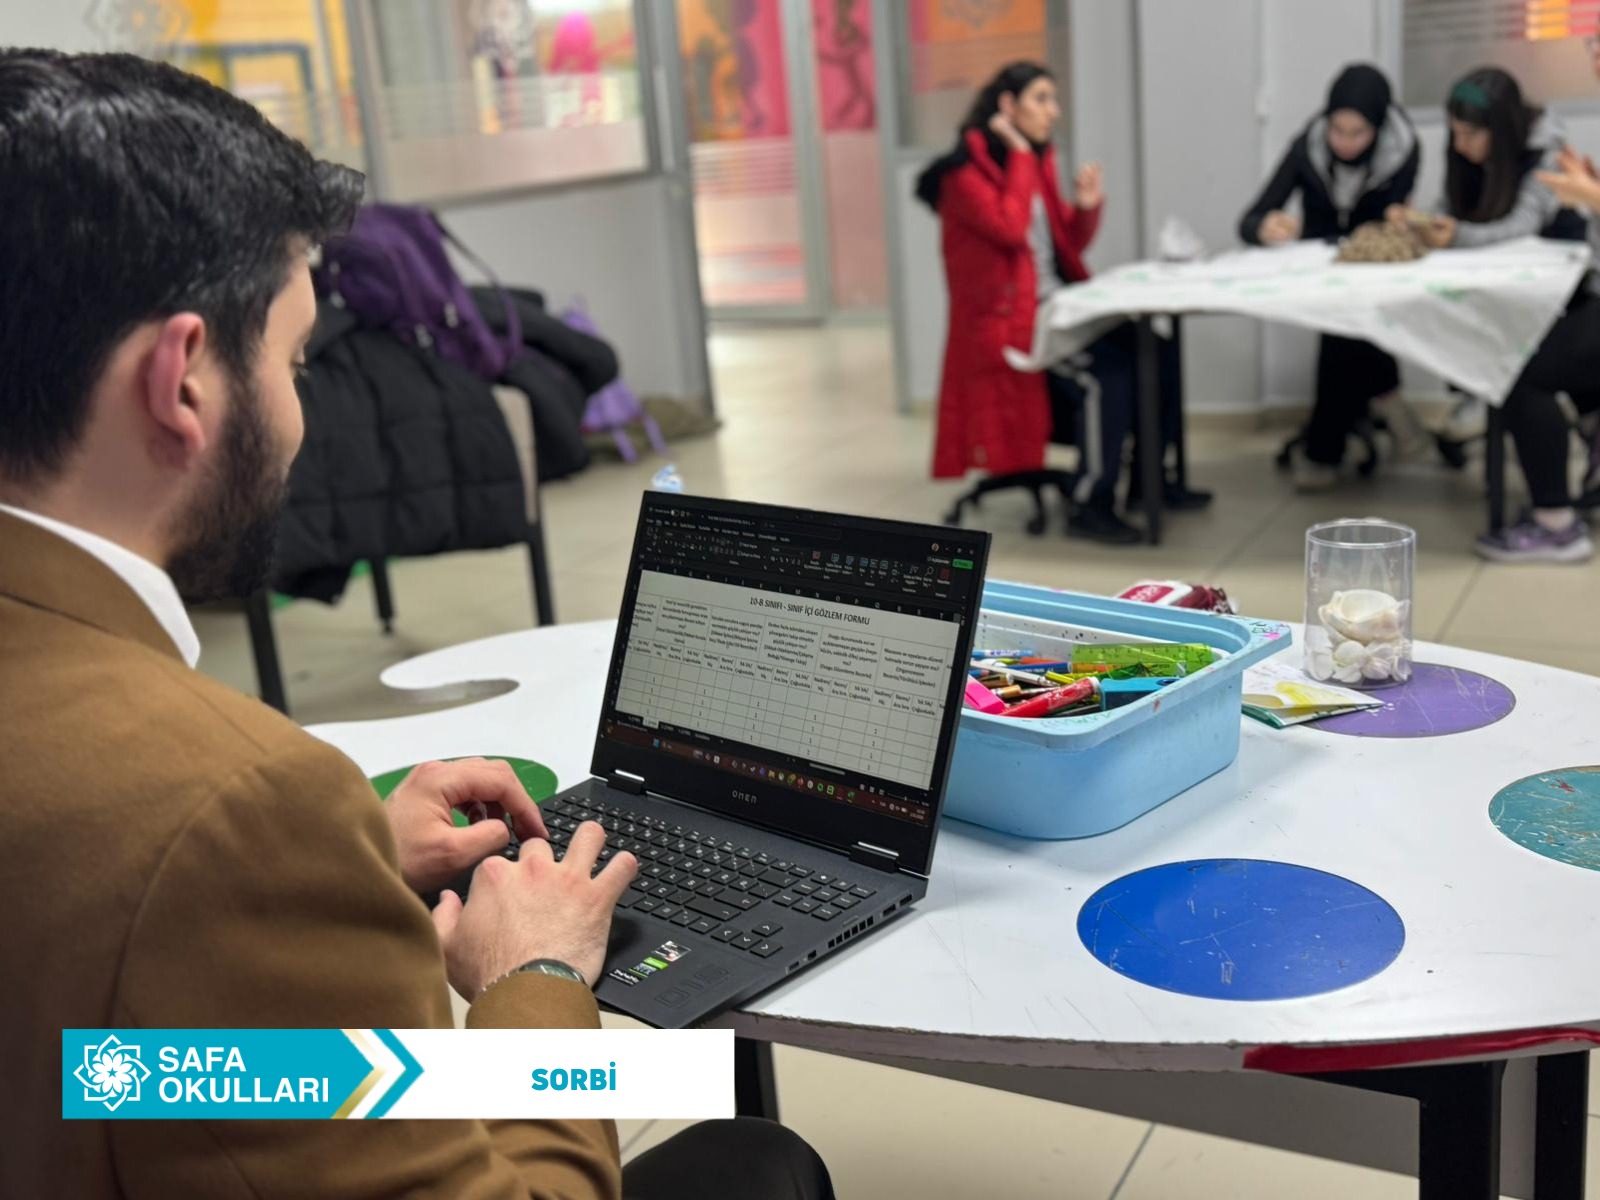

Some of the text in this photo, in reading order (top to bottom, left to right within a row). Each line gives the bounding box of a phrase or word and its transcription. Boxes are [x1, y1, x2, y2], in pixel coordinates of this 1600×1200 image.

[764, 599, 783, 610] SINIFI
[786, 603, 803, 613] SINIF
[804, 605, 813, 616] İÇİ
[814, 607, 842, 620] GÖZLEM
[843, 613, 870, 625] FORMU
[732, 789, 757, 804] OMEN
